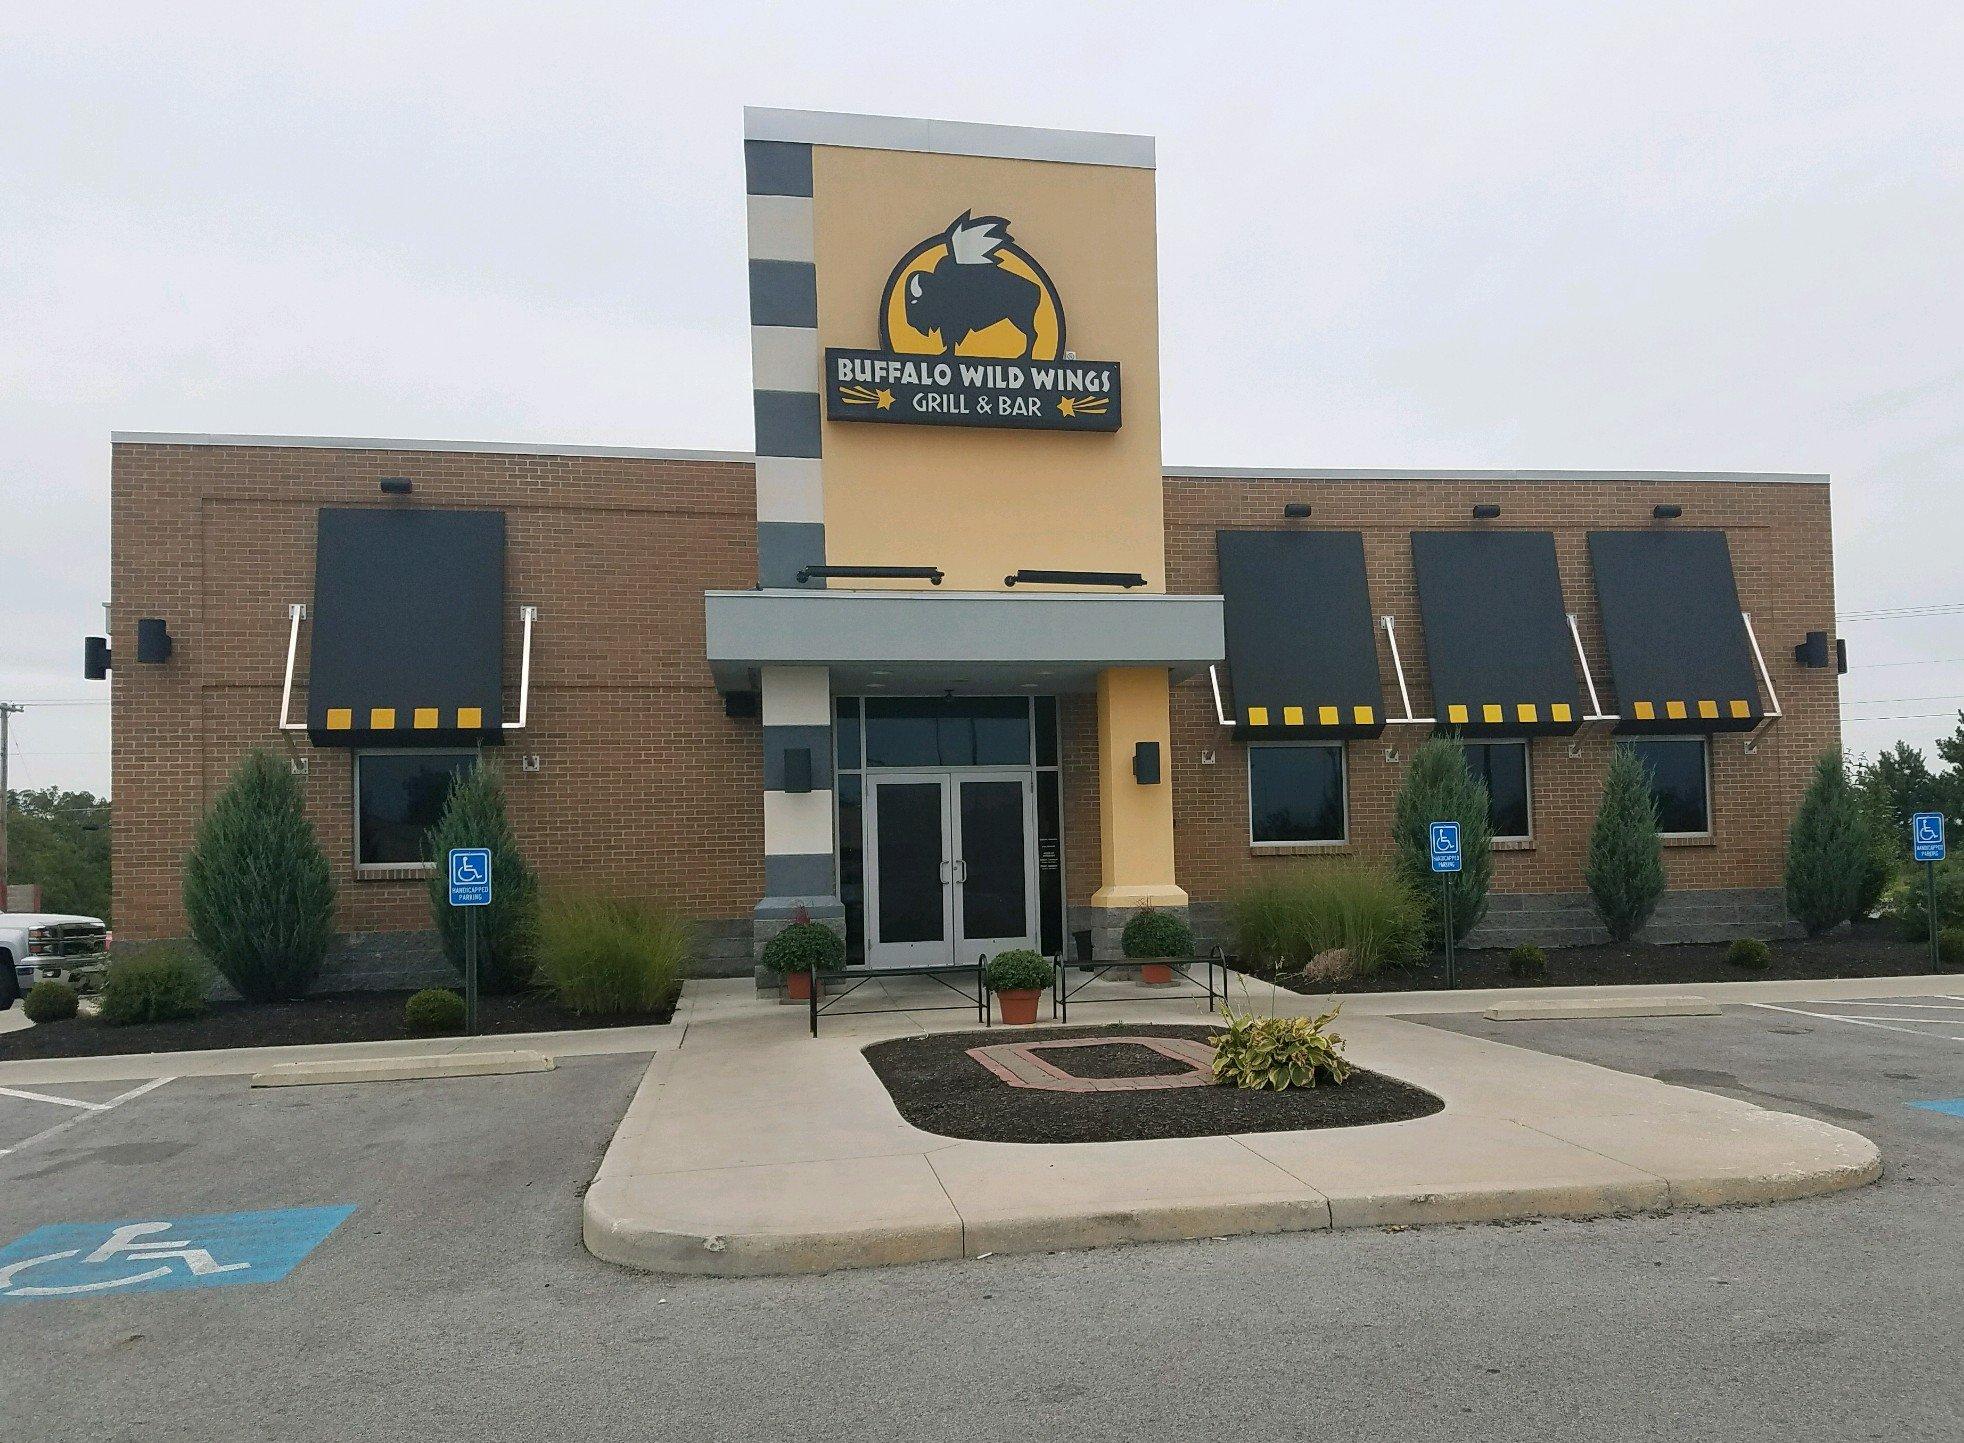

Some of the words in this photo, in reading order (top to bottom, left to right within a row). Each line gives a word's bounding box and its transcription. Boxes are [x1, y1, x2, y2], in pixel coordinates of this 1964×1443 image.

[838, 357, 951, 386] BUFFALO
[959, 364, 1024, 389] WILD
[1031, 368, 1111, 392] WINGS
[912, 392, 970, 414] GRILL
[976, 396, 992, 415] &
[998, 397, 1042, 417] BAR
